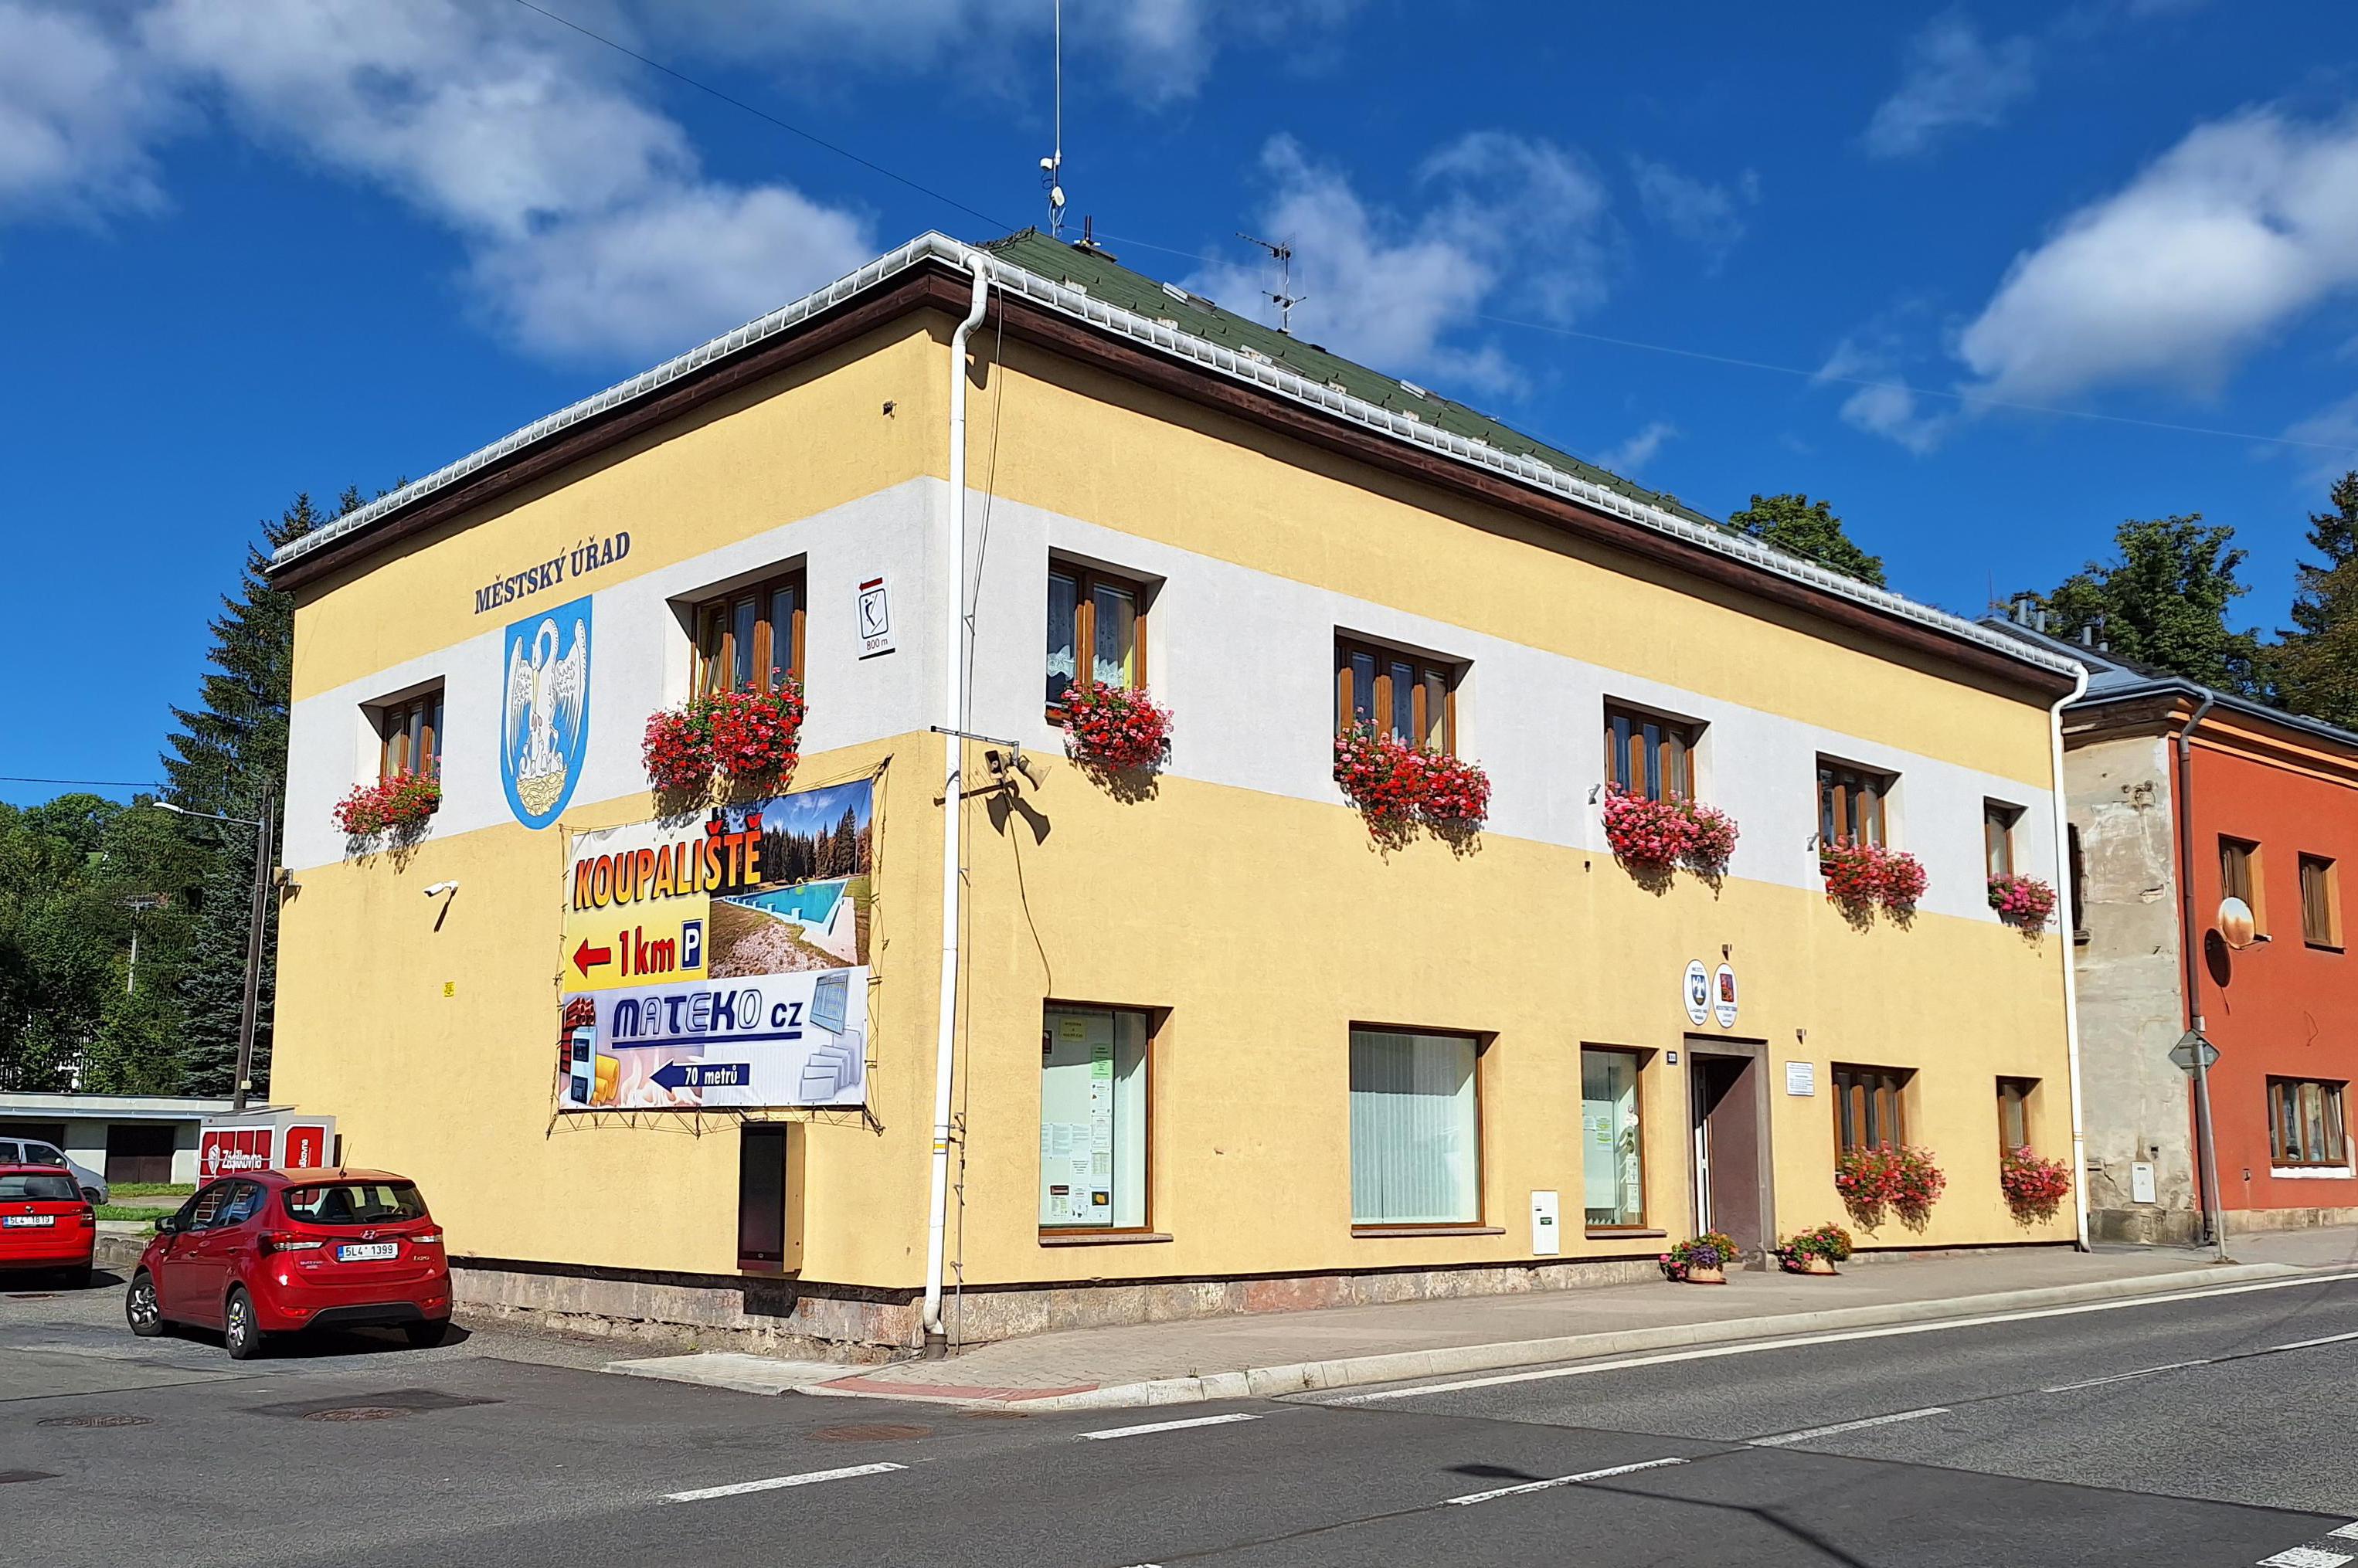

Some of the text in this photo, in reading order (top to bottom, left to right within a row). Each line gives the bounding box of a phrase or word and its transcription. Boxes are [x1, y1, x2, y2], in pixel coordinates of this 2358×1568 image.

[474, 531, 630, 614] MĚSTSKÝ ÚŘAD
[866, 638, 888, 650] 800 m
[574, 813, 763, 911] KOUPALIŠTĚ
[685, 928, 699, 962] P
[611, 989, 762, 1038] MATEKO
[685, 1066, 738, 1085] 70 metrů
[345, 1244, 393, 1257] 5L4 1399
